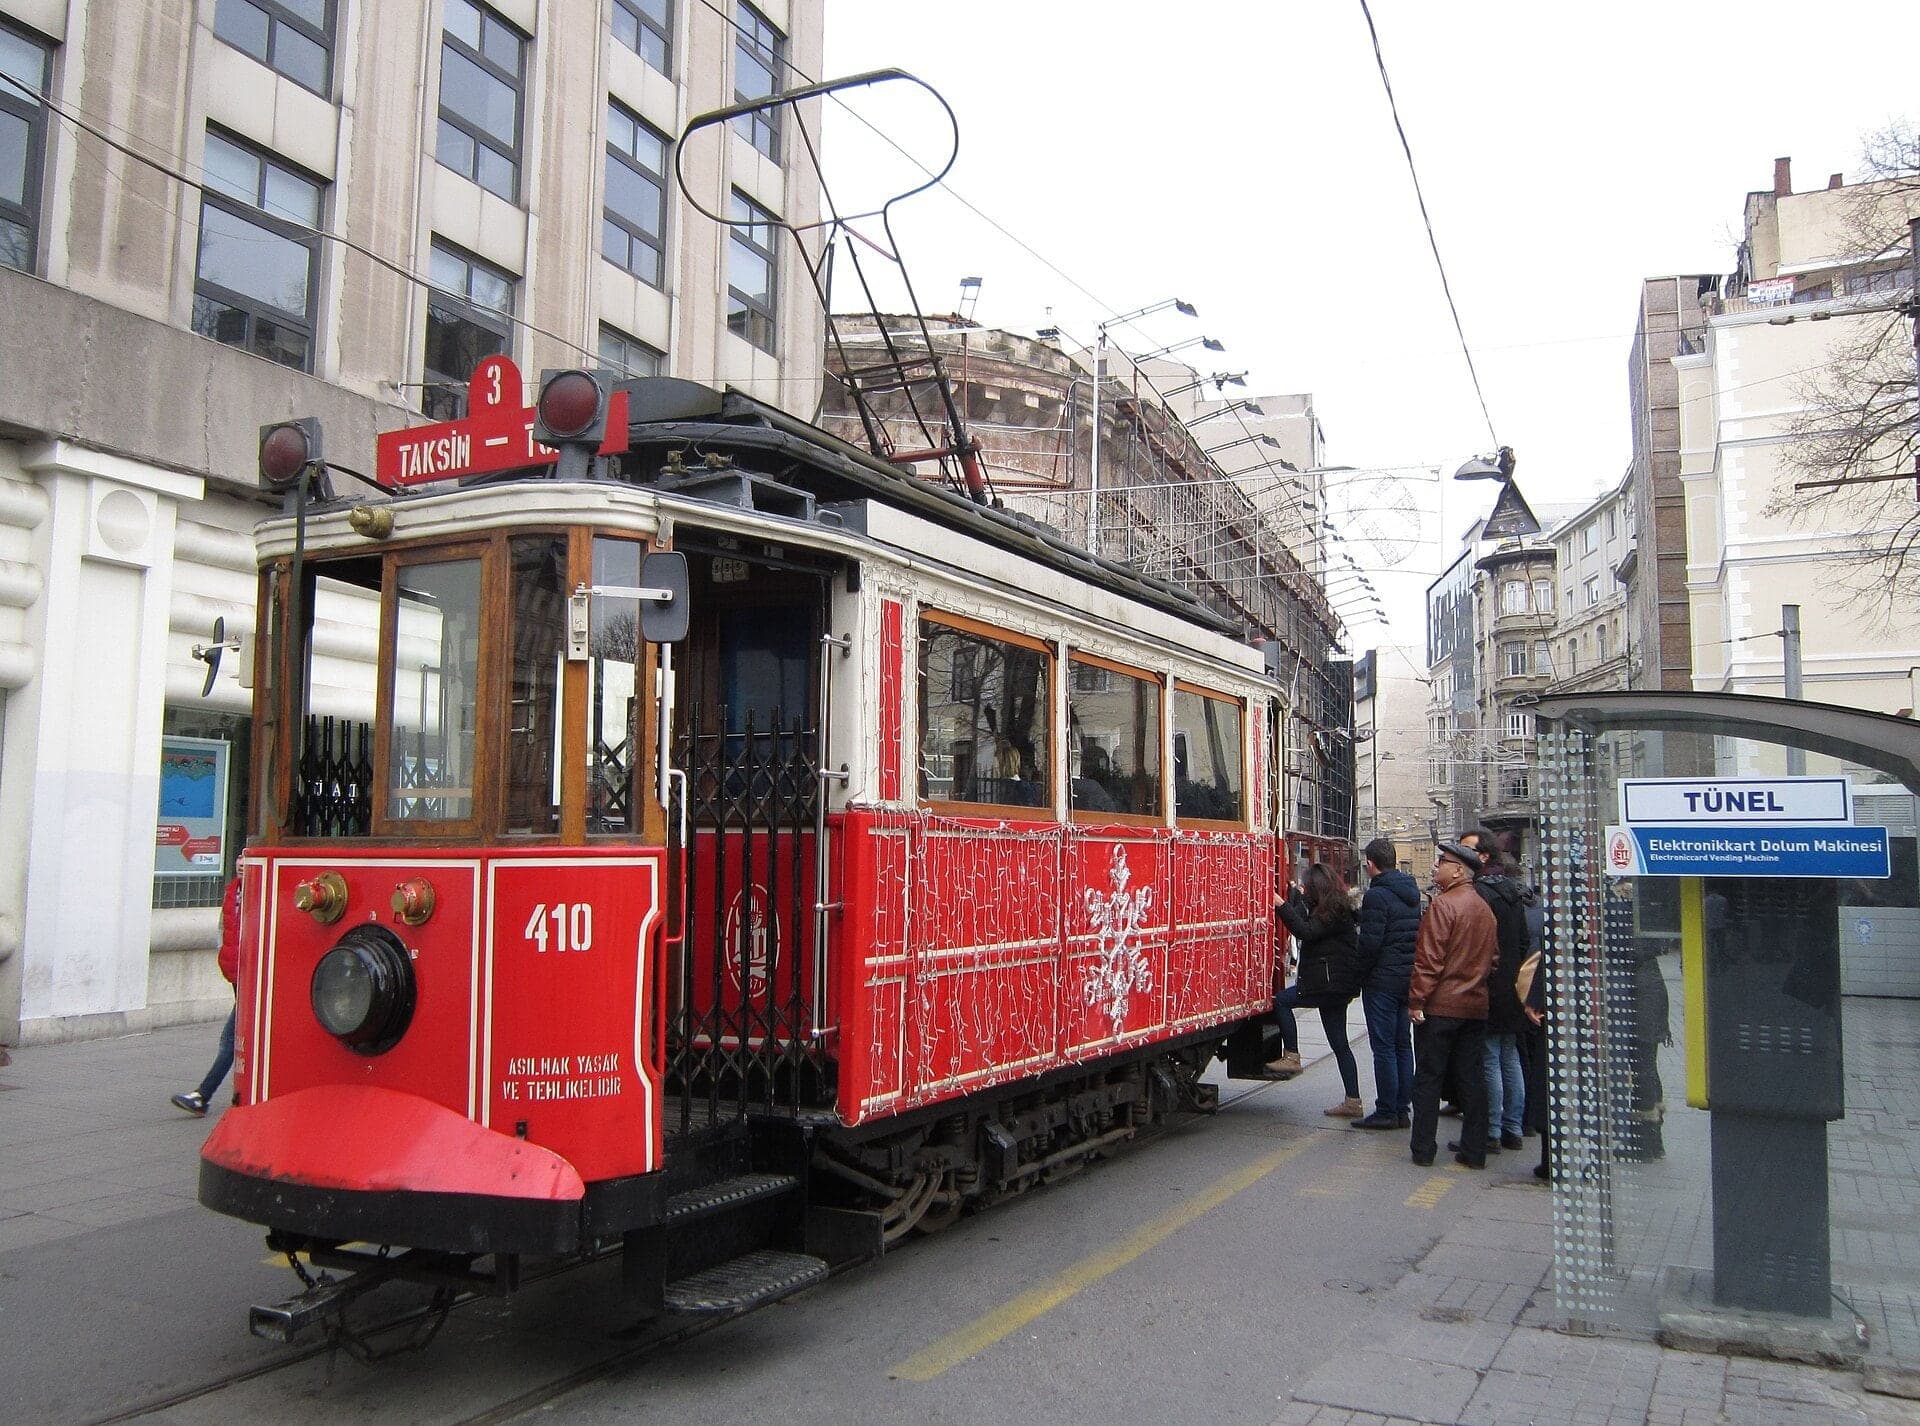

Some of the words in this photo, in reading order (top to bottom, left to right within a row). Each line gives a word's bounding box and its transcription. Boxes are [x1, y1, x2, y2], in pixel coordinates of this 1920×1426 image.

[487, 365, 501, 405] 3
[399, 430, 471, 478] TAKSİM
[1683, 788, 1784, 813] TÜNEL
[1649, 839, 1756, 851] Elektronikkart
[1761, 840, 1810, 852] Dolum
[1814, 840, 1882, 852] Makinesi
[1650, 853, 1708, 861] Electroniccard
[1709, 854, 1743, 863] Vending
[1744, 854, 1779, 862] Machine
[525, 904, 592, 952] 410
[509, 1056, 570, 1076] ASILMAK
[577, 1053, 619, 1074] YASAK
[503, 1081, 519, 1100] VE
[527, 1075, 621, 1100] TEHLİKELİDİR
